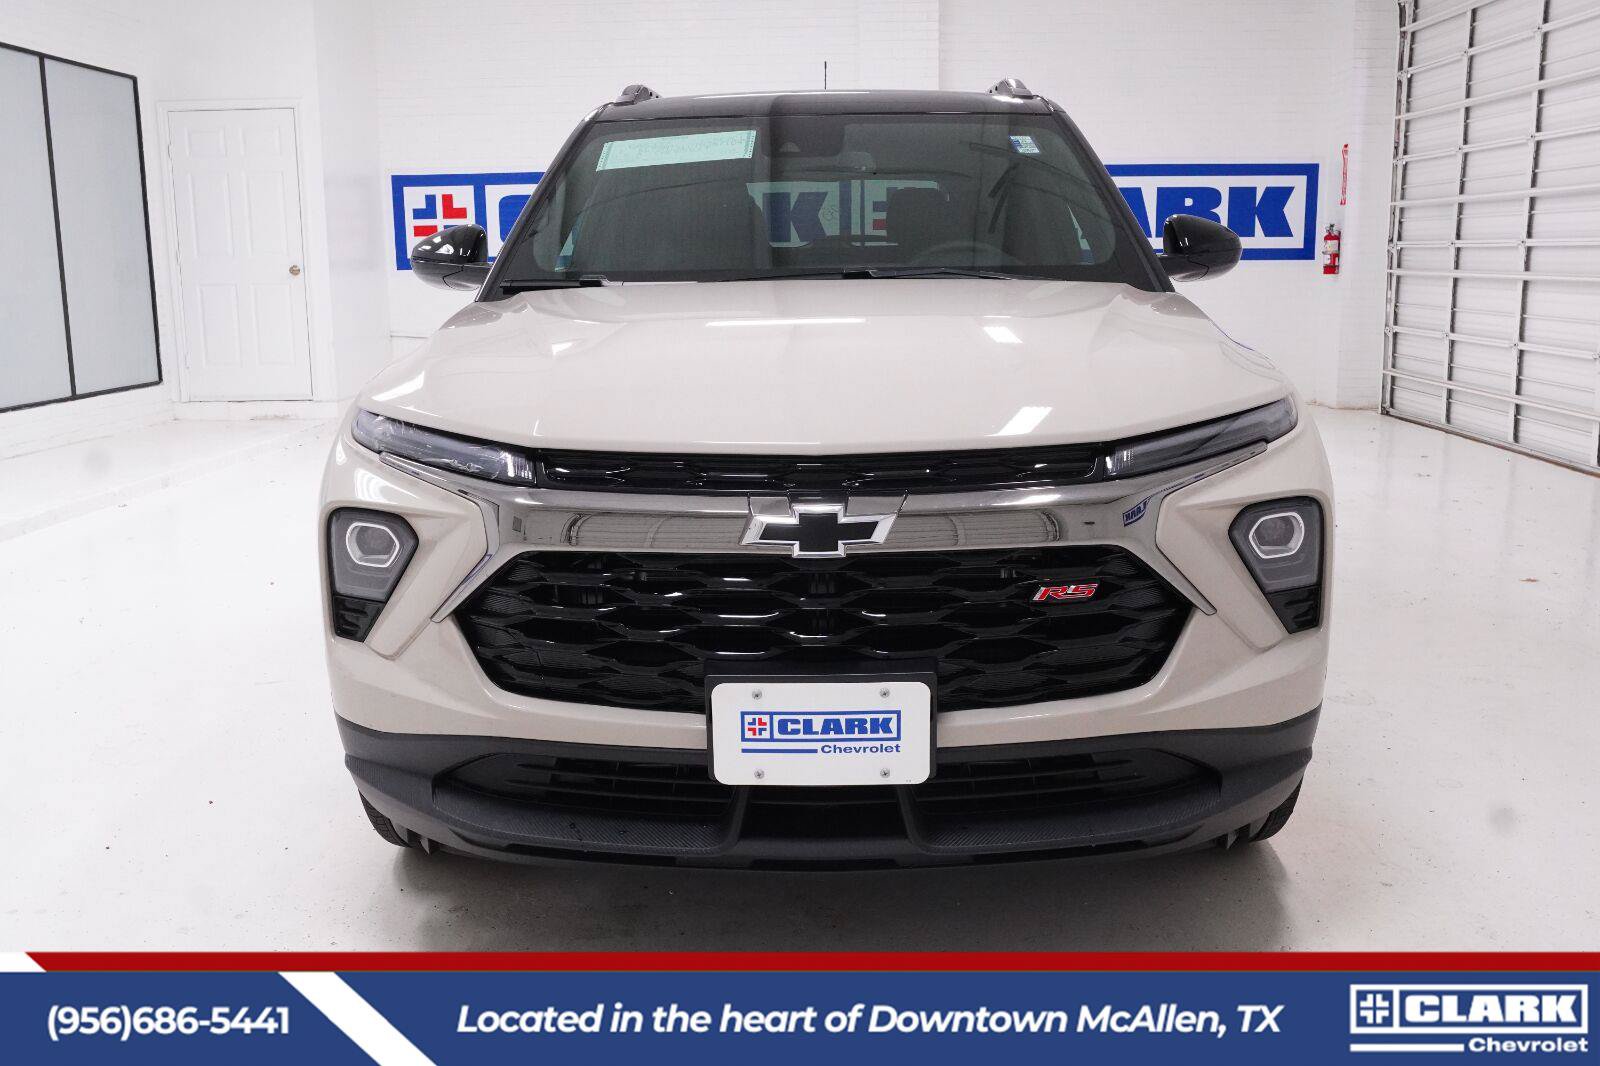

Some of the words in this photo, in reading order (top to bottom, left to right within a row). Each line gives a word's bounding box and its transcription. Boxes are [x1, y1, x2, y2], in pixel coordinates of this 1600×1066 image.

[1032, 583, 1099, 602] RS
[777, 717, 893, 736] CLARK
[820, 744, 901, 755] Chevrolet
